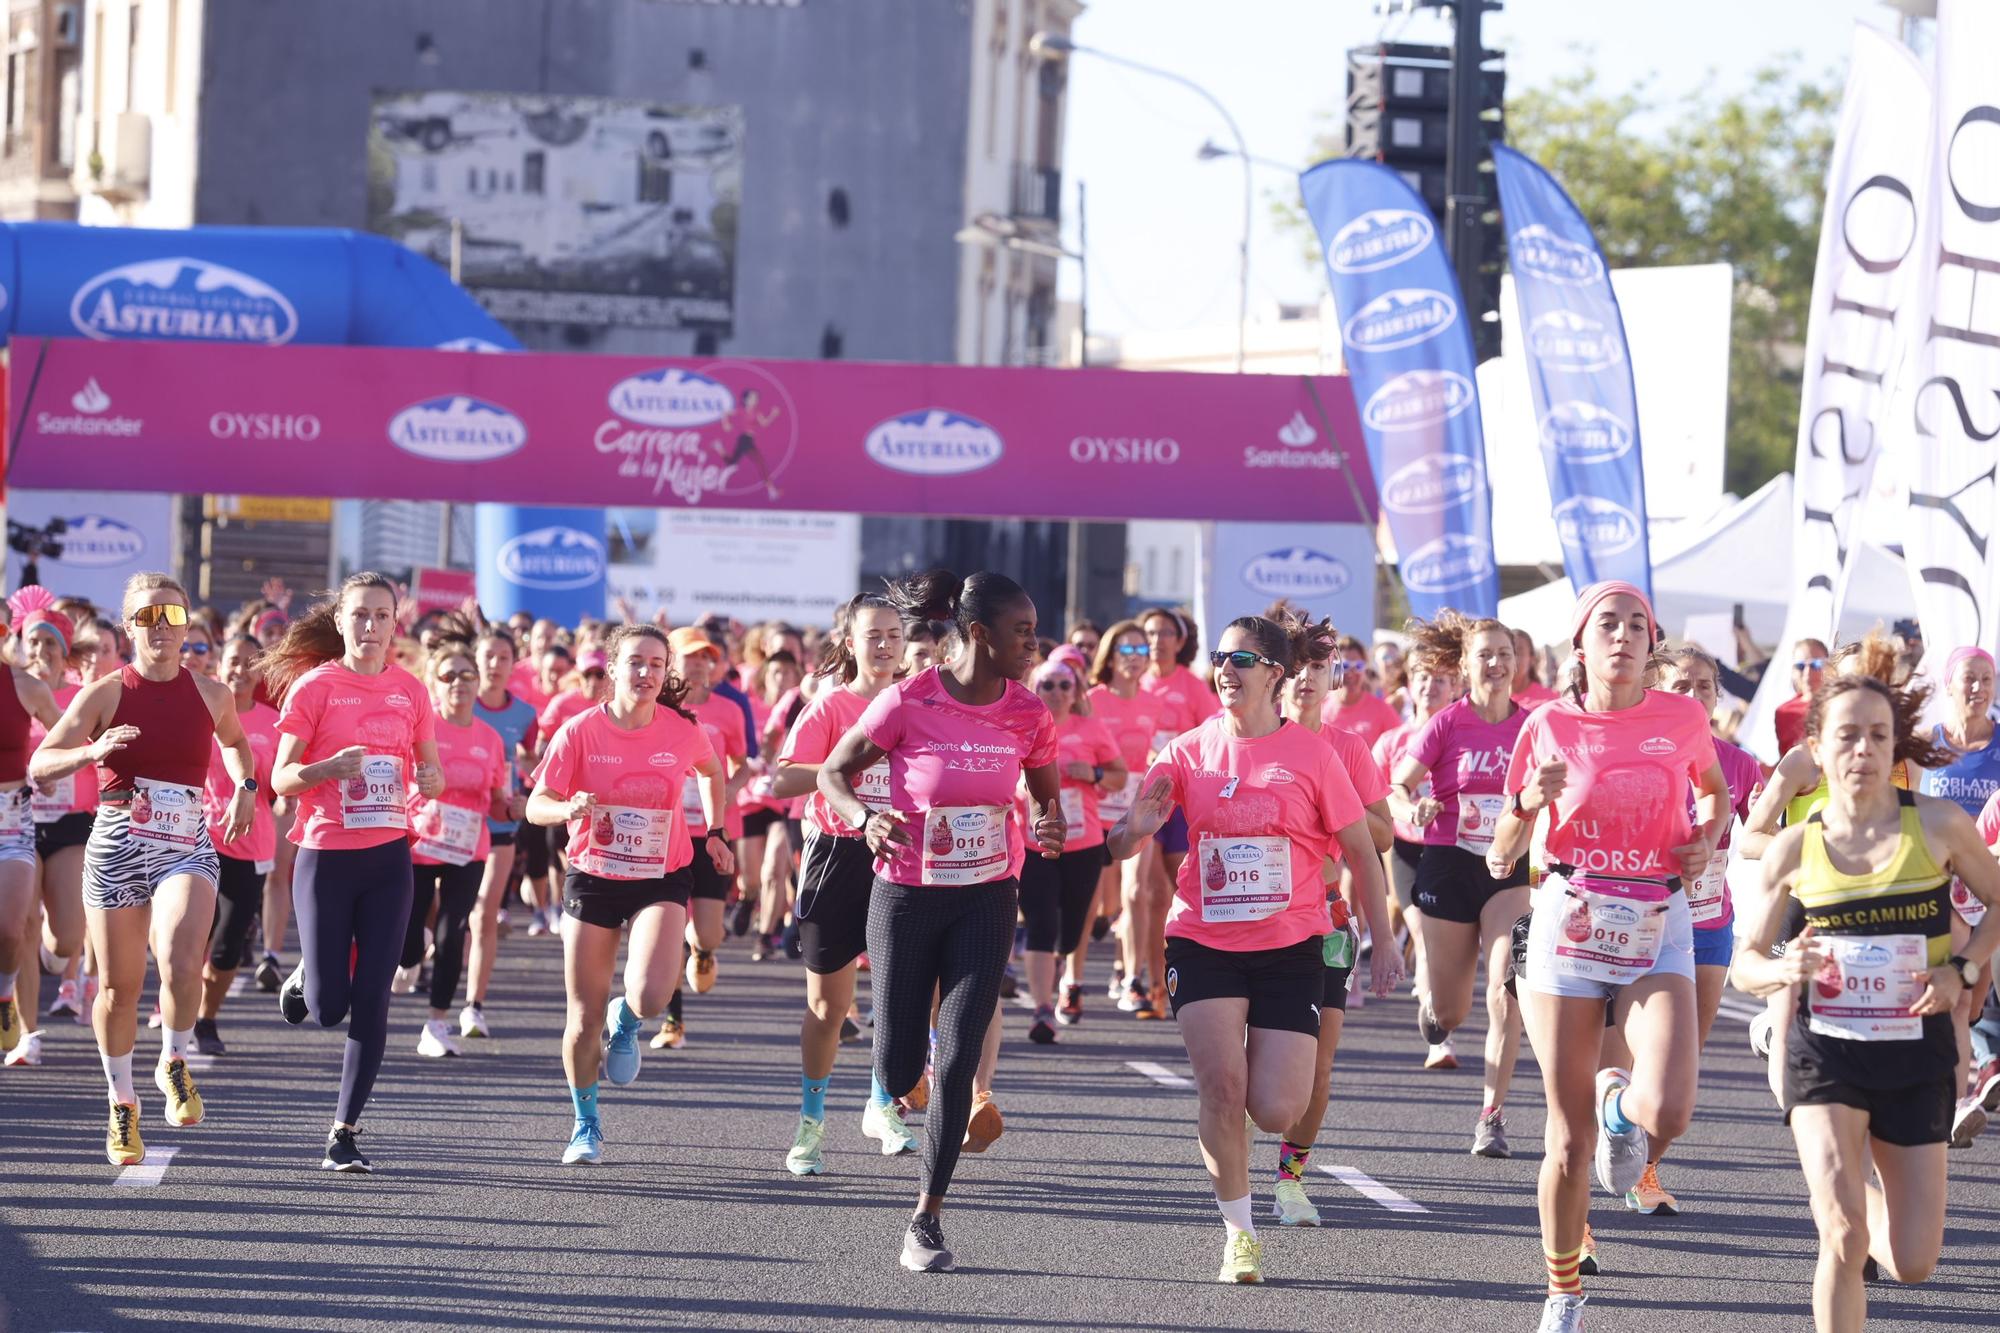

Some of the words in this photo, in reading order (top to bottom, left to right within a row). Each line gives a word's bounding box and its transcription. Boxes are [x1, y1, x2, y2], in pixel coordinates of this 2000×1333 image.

[88, 288, 278, 338] ASTURIANA
[616, 388, 724, 412] ASTURIANA
[36, 412, 143, 436] Santander
[208, 411, 321, 441] OYSHO
[401, 419, 515, 444] ASTURIANA
[593, 419, 704, 454] Carrera
[878, 431, 990, 457] ASTURIANA
[1069, 435, 1180, 465] OYSHO
[617, 451, 642, 478] de
[642, 451, 660, 478] la
[652, 451, 739, 504] Mujer
[63, 540, 137, 553] TURIANA
[329, 696, 362, 706] OYSHO
[927, 740, 960, 752] Sports
[972, 743, 1016, 755] Santander
[1559, 743, 1605, 756] OYSHO
[588, 754, 623, 765] OYSHO
[865, 773, 890, 786] 016
[1194, 769, 1231, 779] OYSHO
[370, 783, 395, 794] 016
[872, 786, 881, 794] 93
[1929, 776, 1999, 792] POBLATS
[154, 811, 180, 824] 016
[955, 819, 985, 828] ASTURIANA
[1483, 816, 1496, 828] 01
[157, 823, 174, 832] 3531
[1568, 819, 1600, 839] TU
[616, 833, 642, 846] 016
[956, 836, 985, 849] 016
[963, 850, 978, 859] 350
[1226, 851, 1260, 860] ASTURIANA
[1572, 847, 1662, 872] DORSAL
[1228, 869, 1260, 883] 016
[1242, 884, 1246, 892] 1
[1209, 908, 1235, 917] OYSHO
[1594, 928, 1629, 945] 016
[1597, 943, 1620, 954] 4266
[1847, 976, 1886, 991] 016
[1860, 995, 1871, 1003] 11
